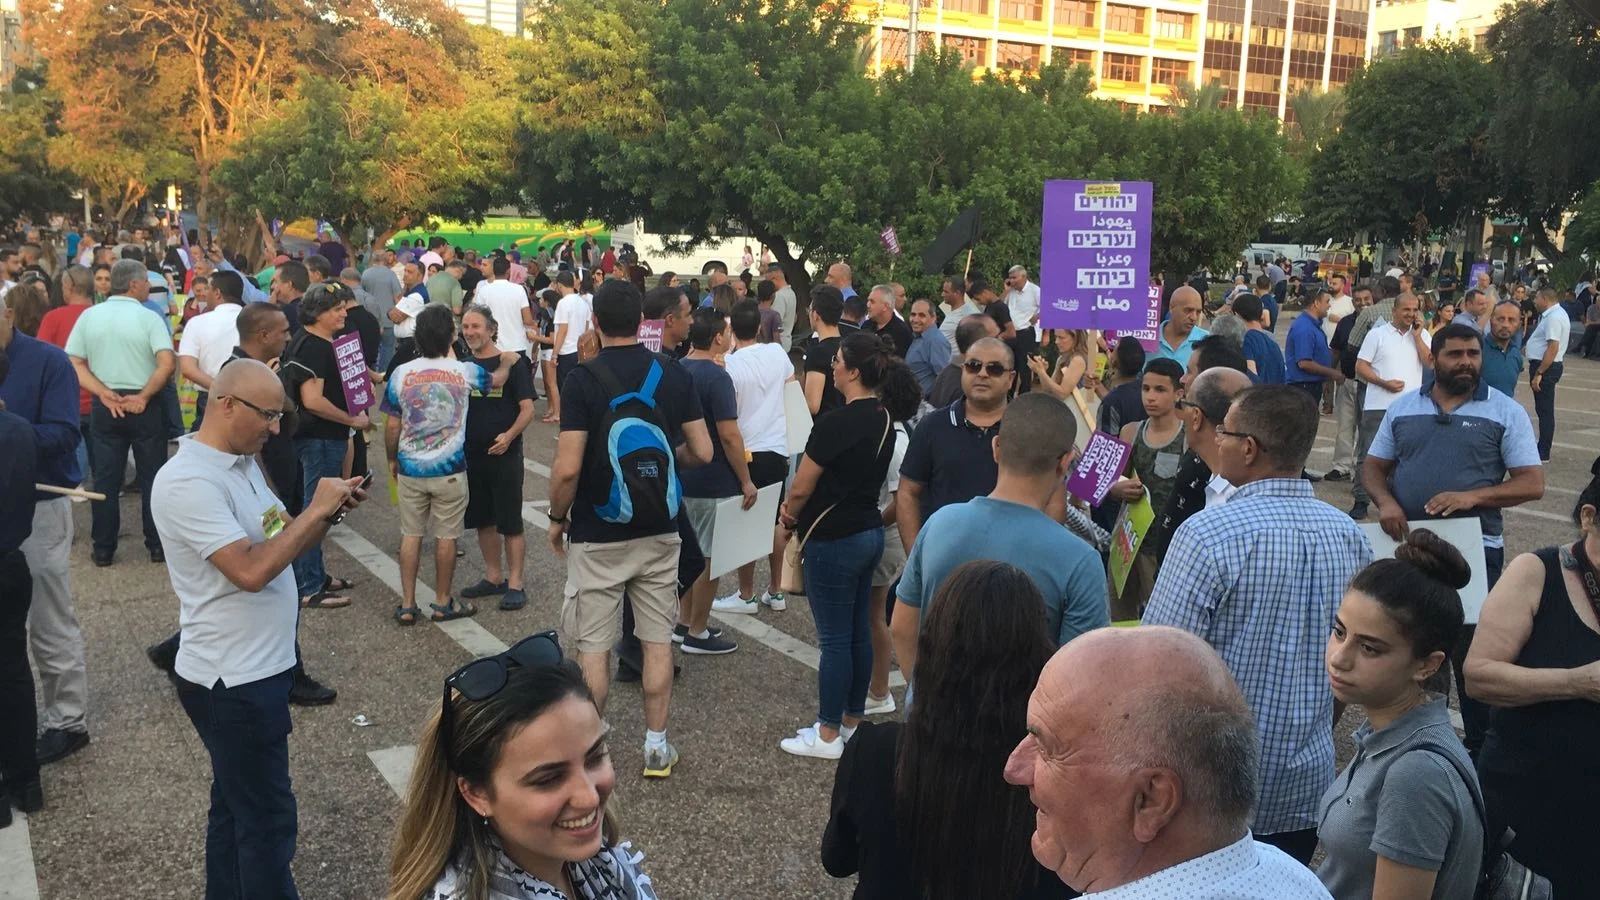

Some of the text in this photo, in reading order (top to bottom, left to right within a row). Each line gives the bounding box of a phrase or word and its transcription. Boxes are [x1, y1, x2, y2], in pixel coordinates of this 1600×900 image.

[1079, 195, 1133, 208] יהודים
[1072, 233, 1132, 246] וערבים
[1079, 271, 1130, 286] ביחד.
[1096, 442, 1115, 472] מלא
[1584, 571, 1599, 595] EOS
